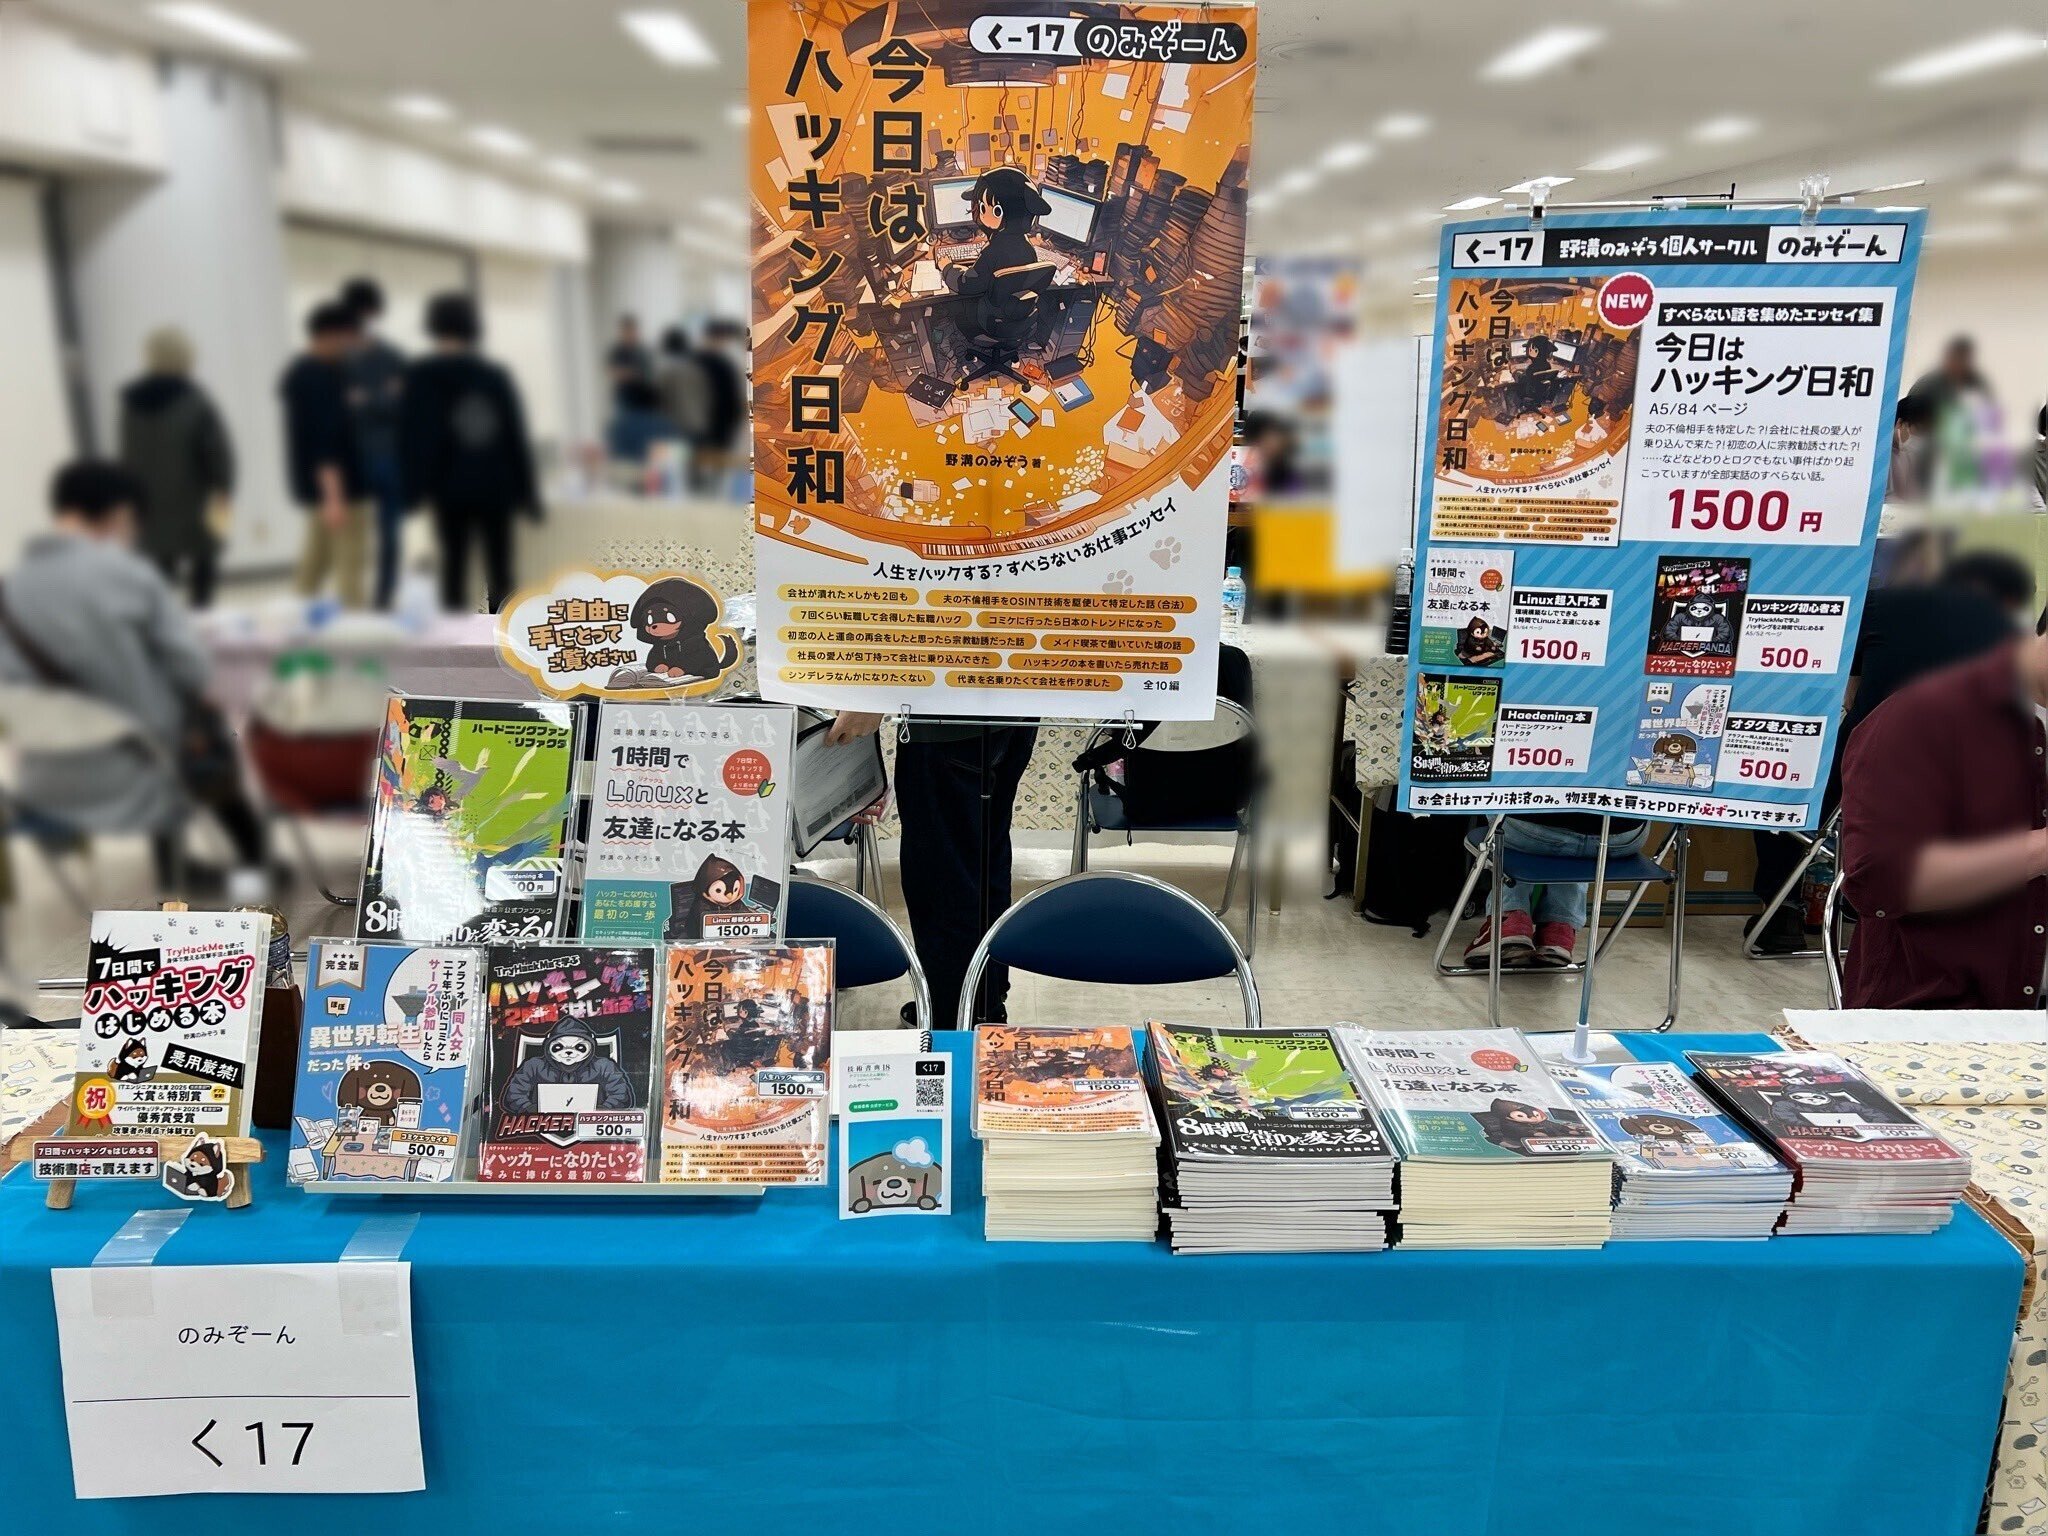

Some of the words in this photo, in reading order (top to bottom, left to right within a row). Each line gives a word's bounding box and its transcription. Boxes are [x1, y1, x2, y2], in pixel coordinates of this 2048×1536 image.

[1086, 19, 1237, 62] のみぞーん
[867, 38, 933, 243] 今日は
[1778, 228, 1887, 258] のみぞーん
[785, 37, 845, 505] ハッキング日和
[1605, 294, 1649, 309] NEW
[1662, 307, 1874, 323] すべらない話を集めたエッセイ集
[1485, 289, 1515, 368] 今日は
[1655, 331, 1745, 363] 今日は
[1442, 290, 1479, 470] ハッキング日和
[1650, 364, 1875, 398] ハッキング日和
[1649, 403, 1698, 415] A5/84
[1702, 402, 1748, 415] ページ
[944, 453, 1029, 468] 野溝のみぞう
[1641, 469, 1826, 482] こっていますが全部実話のすべらない話。
[1430, 567, 1466, 579] 1時間で
[1427, 598, 1491, 612] 友達になる本
[1519, 593, 1600, 608] Linux超入門本
[1750, 602, 1841, 614] ハッキング初心者本
[547, 598, 629, 624] ご自由に
[989, 616, 1163, 629] コミケに行ったら日本のトレンドになった
[528, 624, 623, 651] 手にとって
[1053, 638, 1182, 650] メイド喫茶で働いていた頃の話
[547, 646, 638, 673] ご覧ください
[797, 651, 990, 665] 社長の愛人が包丁持って会社に乗り込んできた
[1023, 658, 1169, 670] ハッキングの本を書いたら売れた話
[788, 671, 926, 682] シンデレラなんかになりたくない
[957, 674, 1110, 688] 代表を名乗りたくて会社を作りました
[471, 723, 569, 737] ハードニングファン
[1730, 718, 1818, 735] オタク老人会本
[611, 745, 690, 769] 1時間で
[606, 779, 709, 805] Linuxと
[602, 816, 746, 843] 友達になる本
[593, 909, 656, 921] 最初の一歩
[96, 957, 156, 980] 7日間で
[325, 960, 360, 971] 完全版
[702, 959, 725, 1026] 今日は
[330, 1001, 345, 1011] ほぼ
[422, 959, 441, 1061] サークル参加したら
[436, 960, 454, 1061] 二十年ぶりにコミケに
[449, 960, 467, 1062] アラフォー同人女が
[96, 1000, 226, 1038] はじめる本
[309, 1022, 422, 1050] 異世界転生
[984, 1031, 1006, 1101] ハッキング日和
[86, 1087, 108, 1110] 祝
[166, 1091, 202, 1102] 特別賞
[137, 1112, 196, 1124] 優秀賞受賞
[499, 1115, 576, 1136] HACKER
[401, 1133, 449, 1144] コミケエッセイ本
[1790, 1126, 1857, 1136] HACKER
[38, 1147, 154, 1156] 7日間でハッキングをはじめる本
[486, 1151, 637, 1169] ハッカーになりたい?
[38, 1162, 154, 1176] 技術書店で買えます
[178, 1325, 296, 1345] のみぞーん
